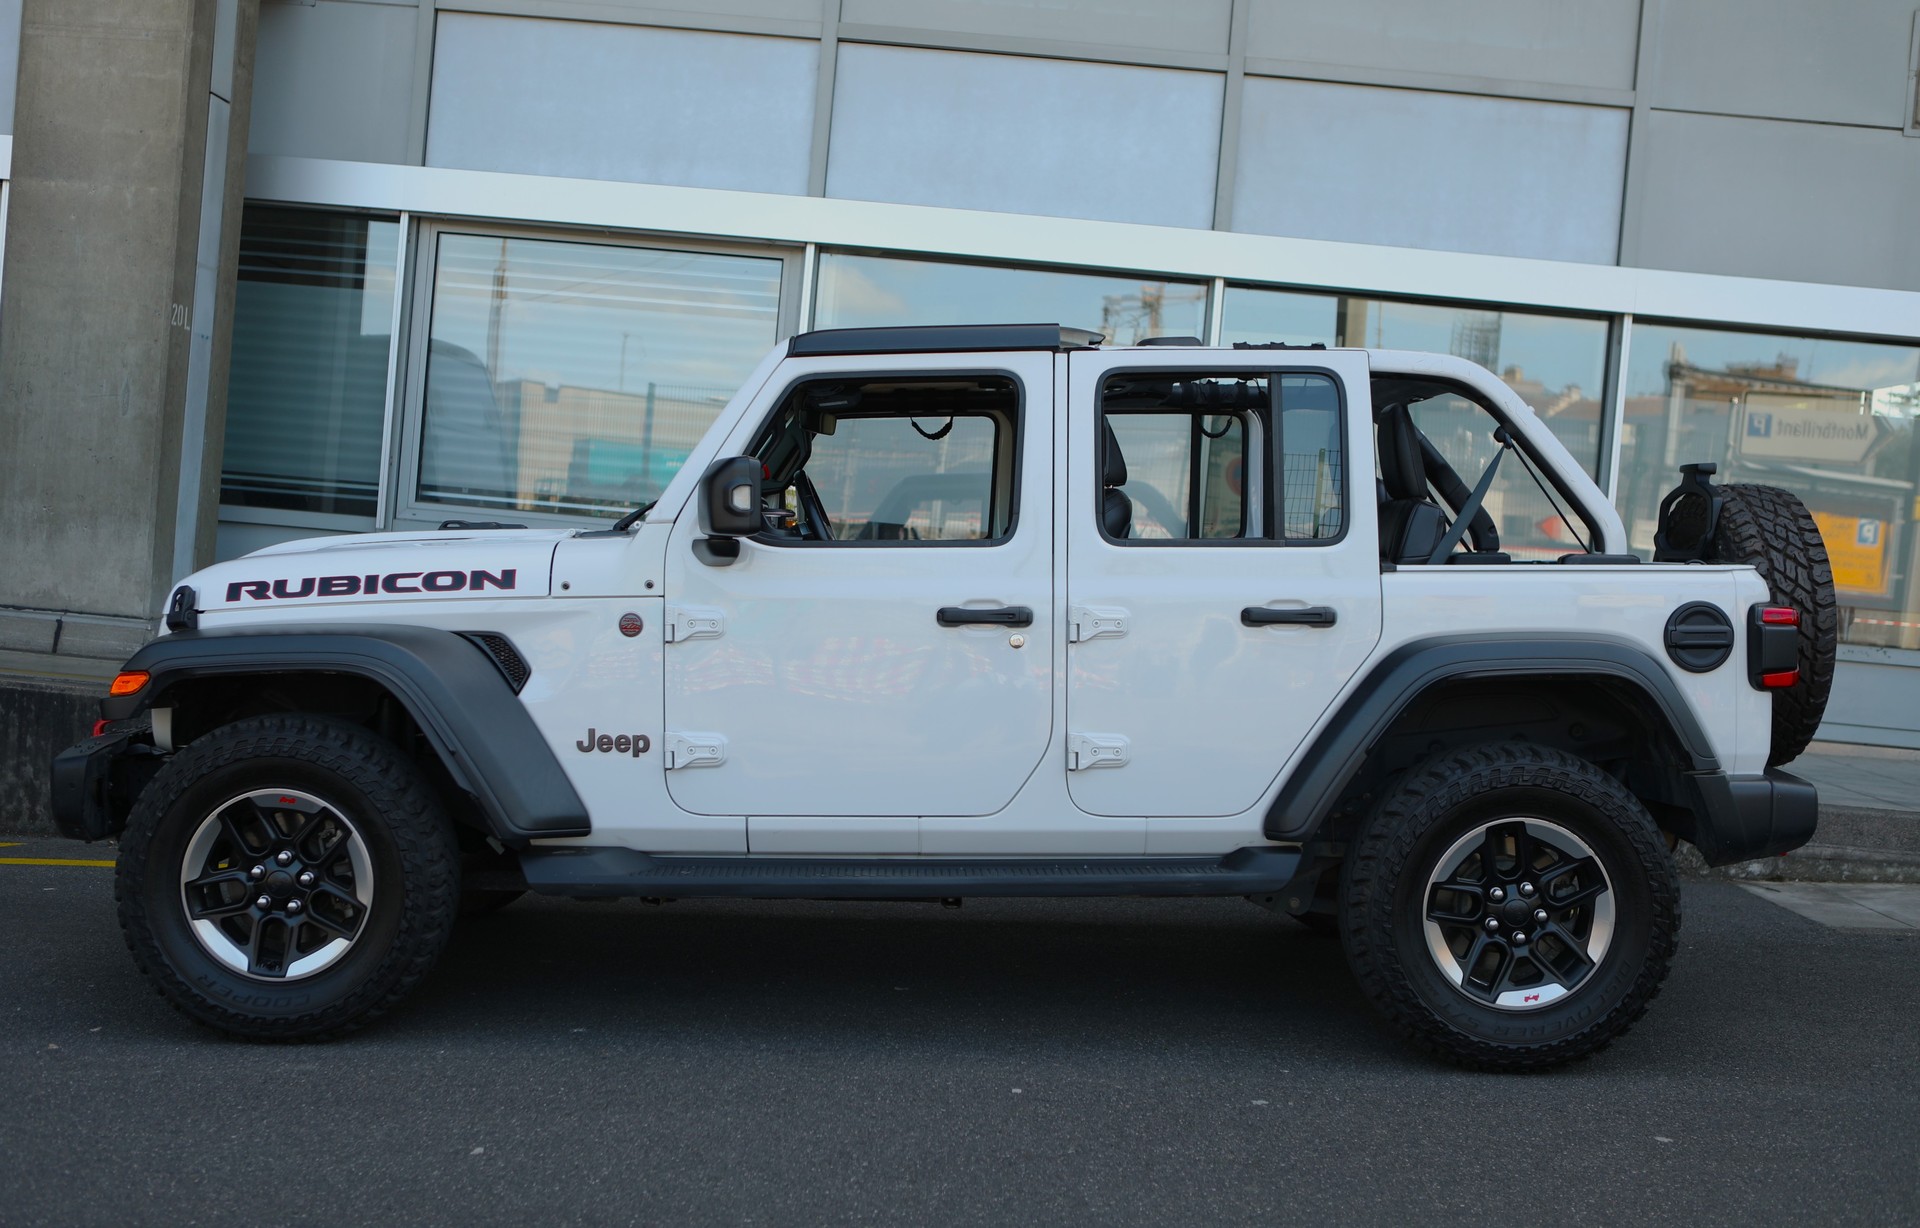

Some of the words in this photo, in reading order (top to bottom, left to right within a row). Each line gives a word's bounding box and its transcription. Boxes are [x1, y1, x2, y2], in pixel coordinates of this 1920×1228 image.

[225, 569, 517, 602] RUBICON
[576, 728, 650, 758] Jeep
[197, 973, 311, 1008] COOPER
